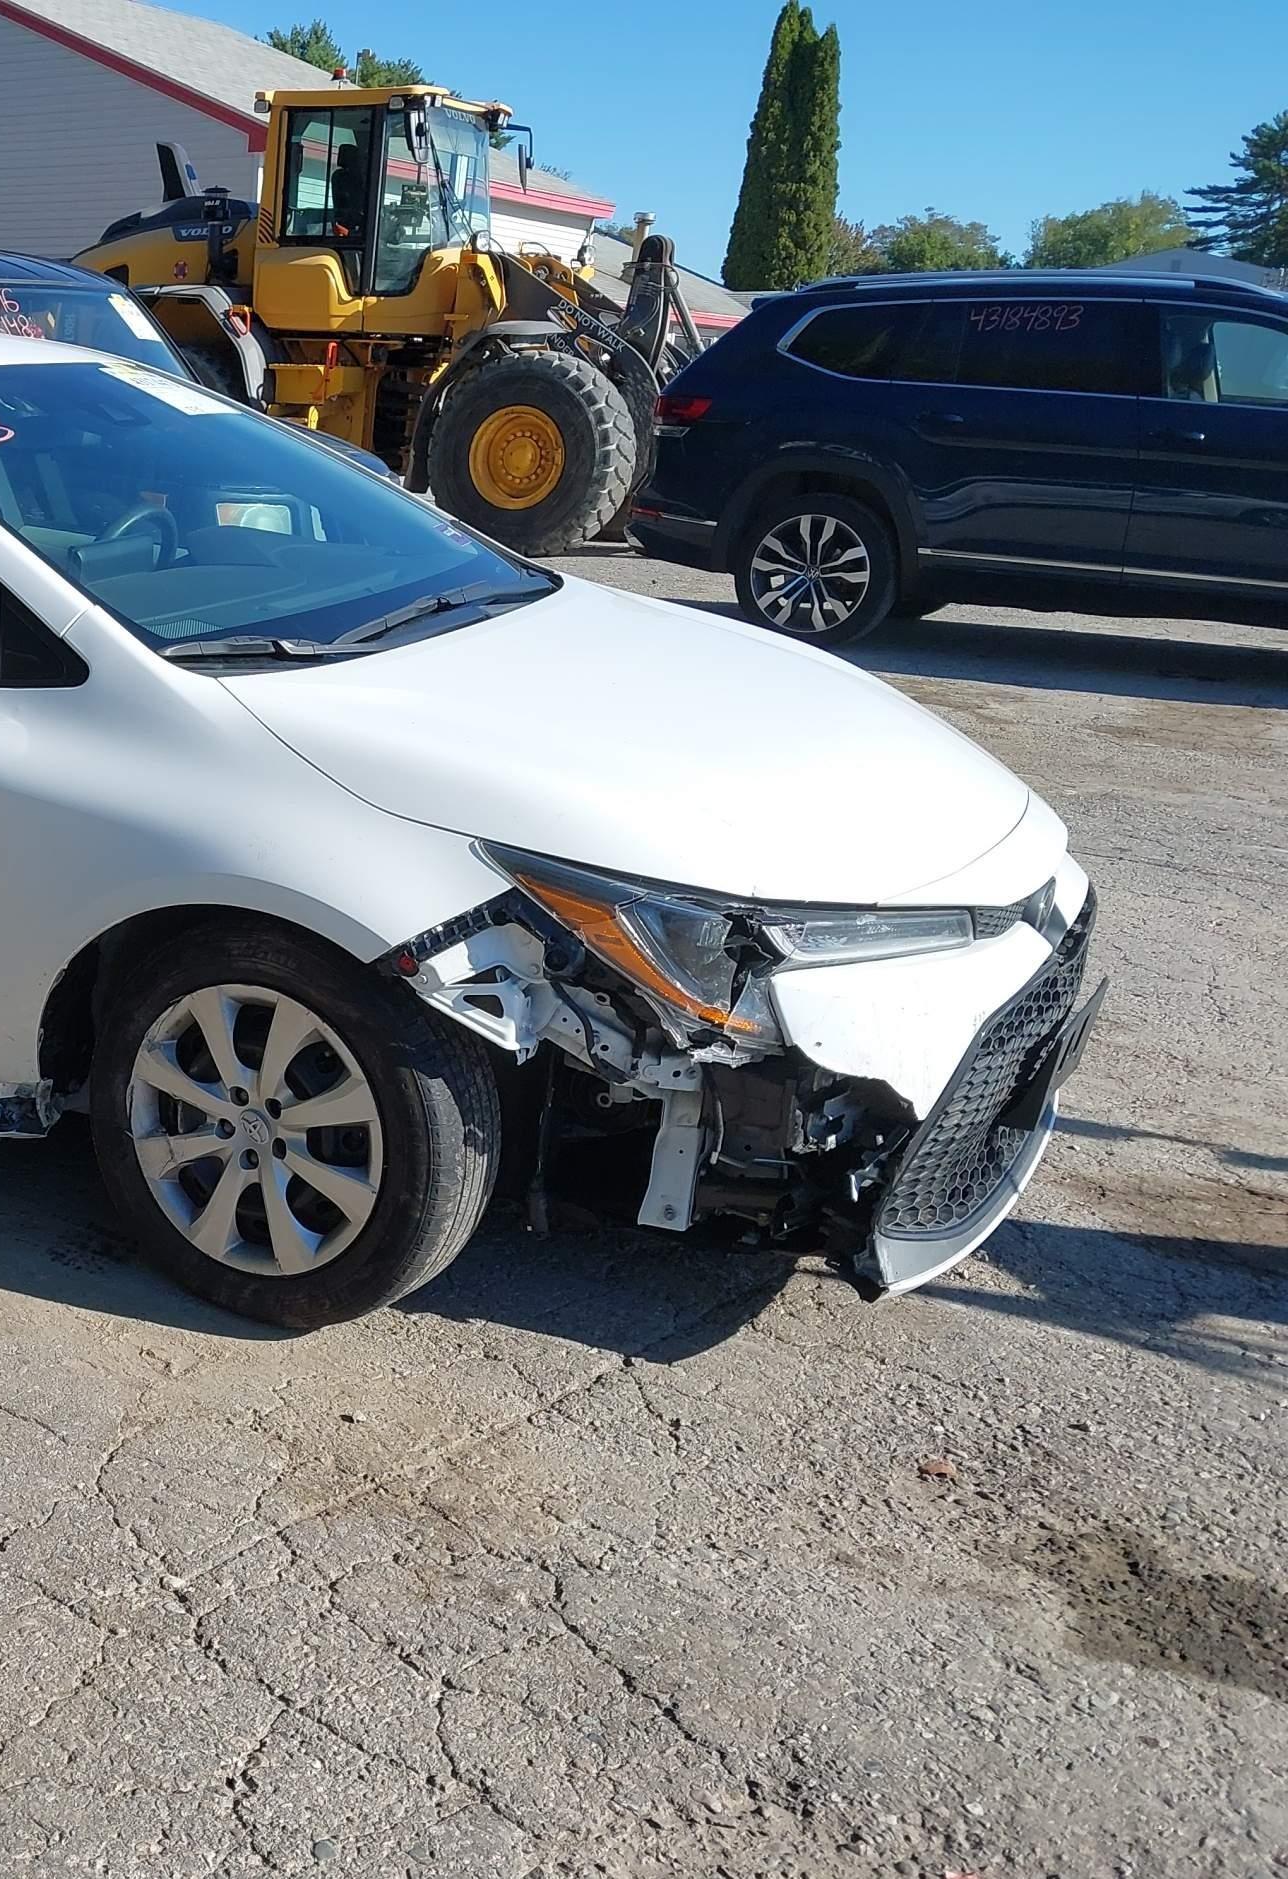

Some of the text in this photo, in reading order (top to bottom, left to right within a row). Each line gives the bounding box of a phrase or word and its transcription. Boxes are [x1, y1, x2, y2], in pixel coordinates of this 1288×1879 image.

[443, 107, 476, 124] VOLVO
[180, 225, 232, 237] VOLO
[557, 299, 626, 353] DO NOT WALK
[969, 304, 1084, 332] 43184893
